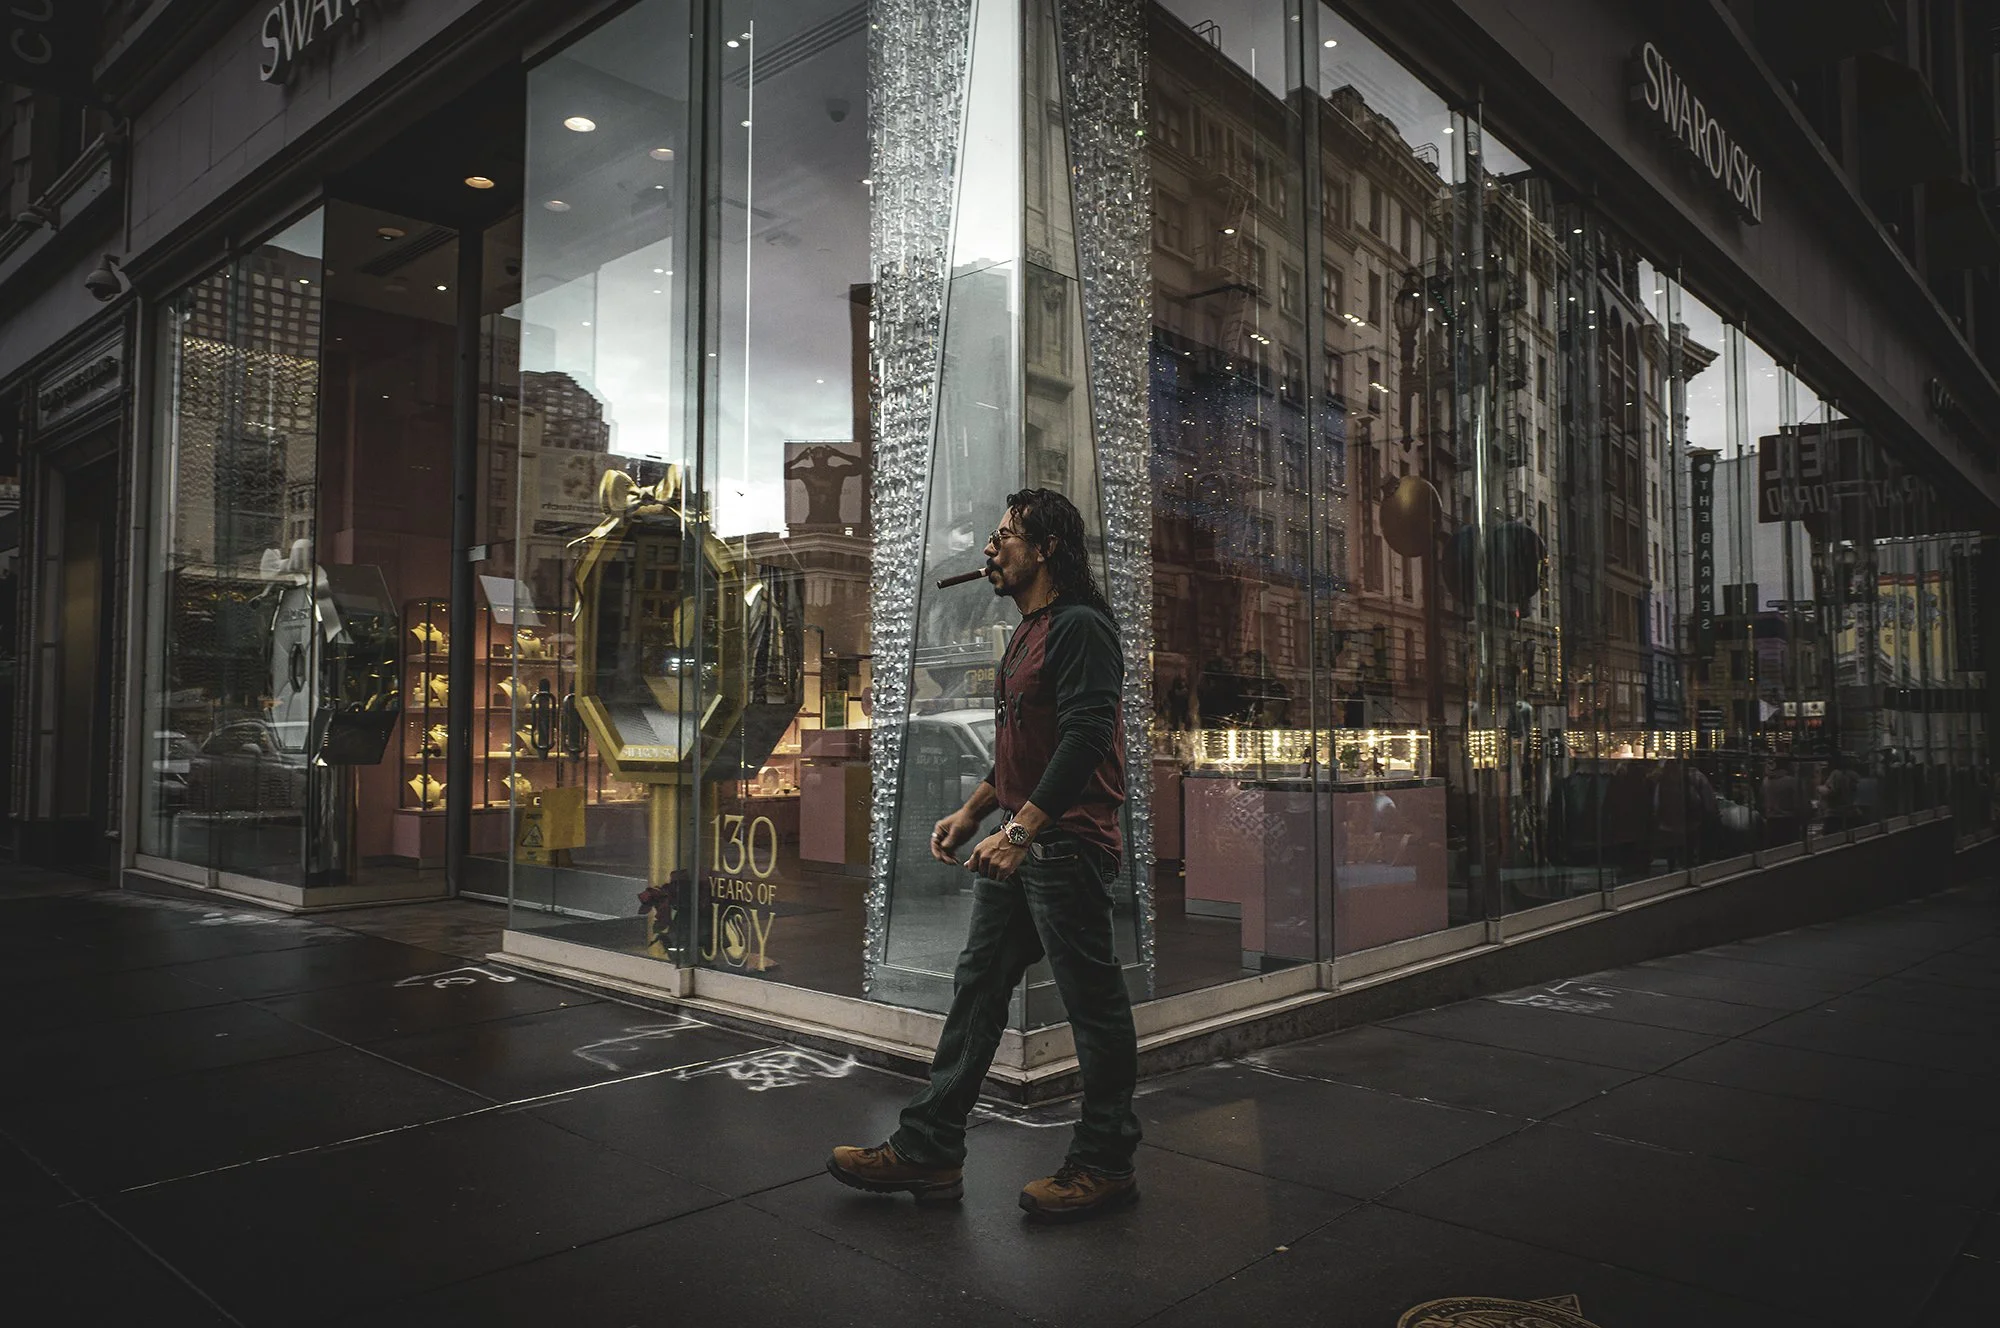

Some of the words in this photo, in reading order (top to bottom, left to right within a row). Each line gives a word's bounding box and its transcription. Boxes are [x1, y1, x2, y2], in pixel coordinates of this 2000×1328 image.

[1642, 41, 1762, 223] SWAROVSKI
[709, 814, 778, 879] 130
[708, 876, 754, 903] YEARS
[756, 882, 778, 907] OF
[701, 903, 777, 972] JOY
